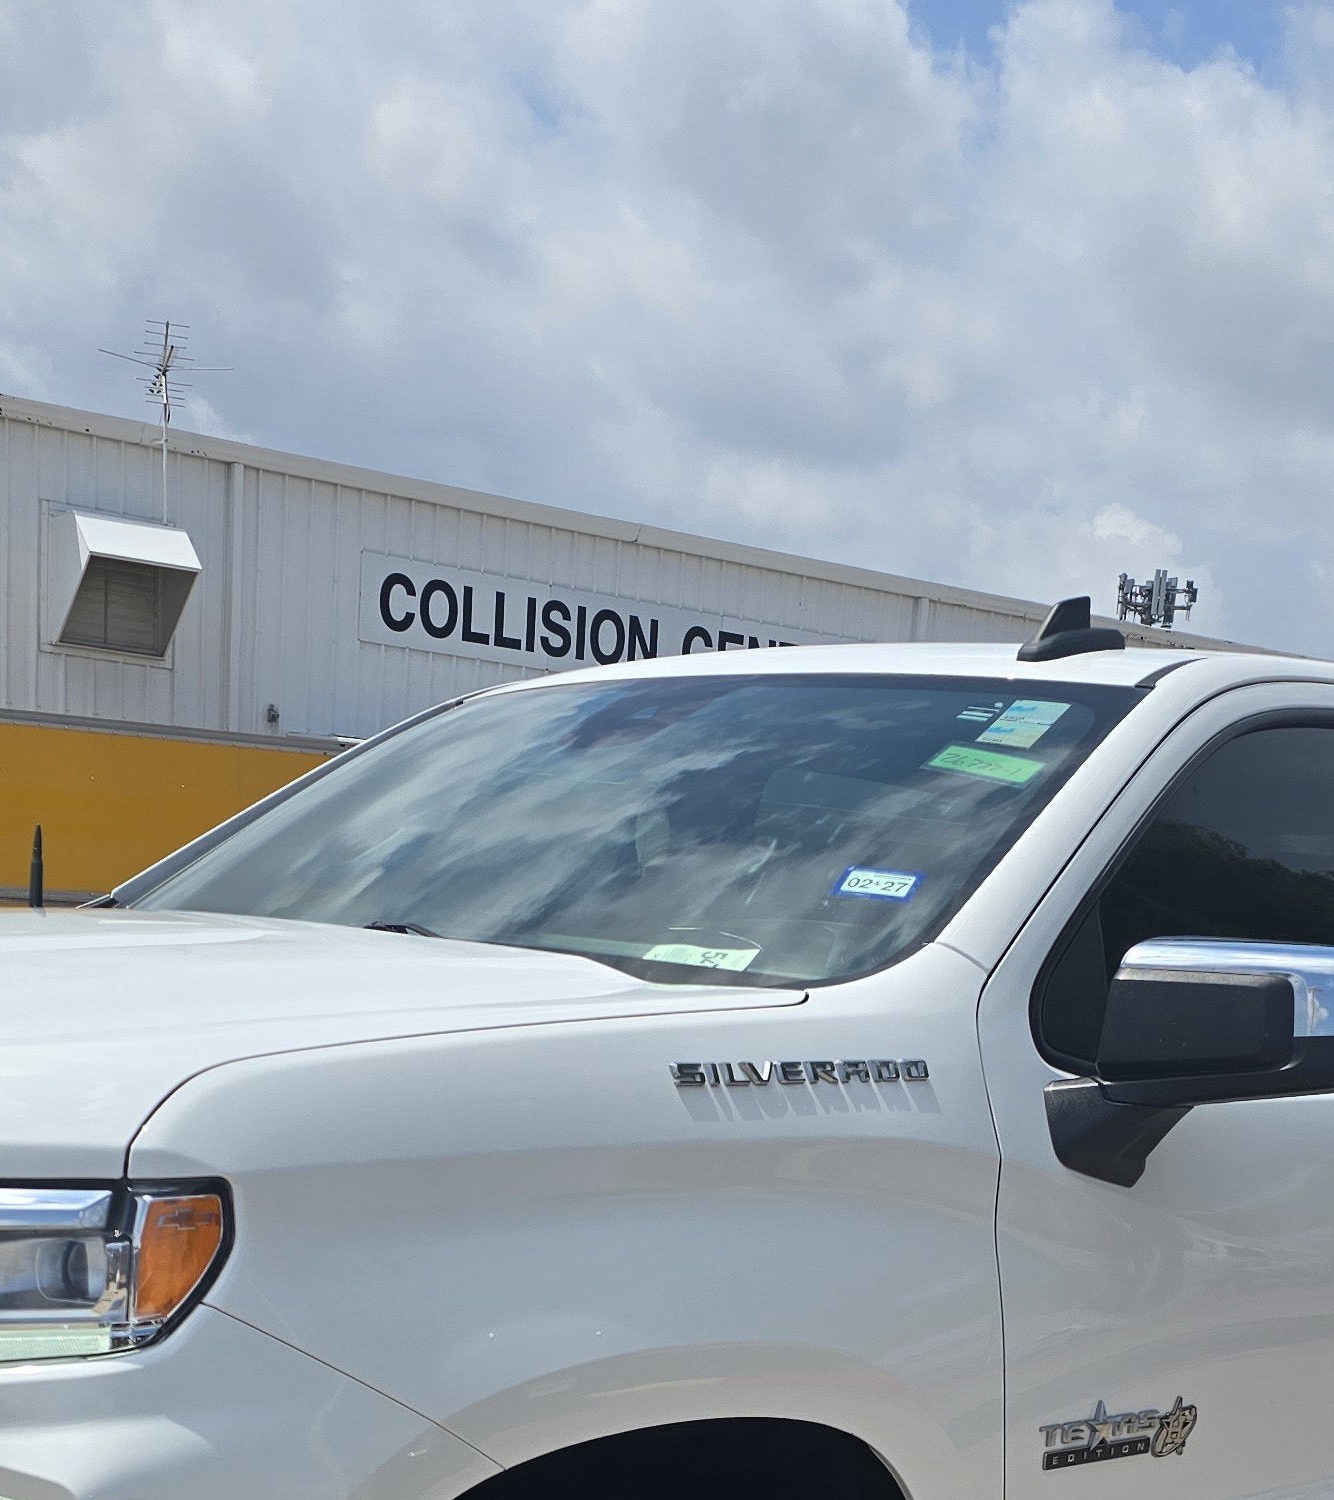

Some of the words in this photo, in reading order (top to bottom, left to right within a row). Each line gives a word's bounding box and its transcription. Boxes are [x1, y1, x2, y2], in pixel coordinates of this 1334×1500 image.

[380, 573, 658, 665] COLLISION
[669, 1058, 930, 1087] SILVERADO
[1039, 1400, 1161, 1451] TEXAS
[1051, 1442, 1146, 1466] EDITION
